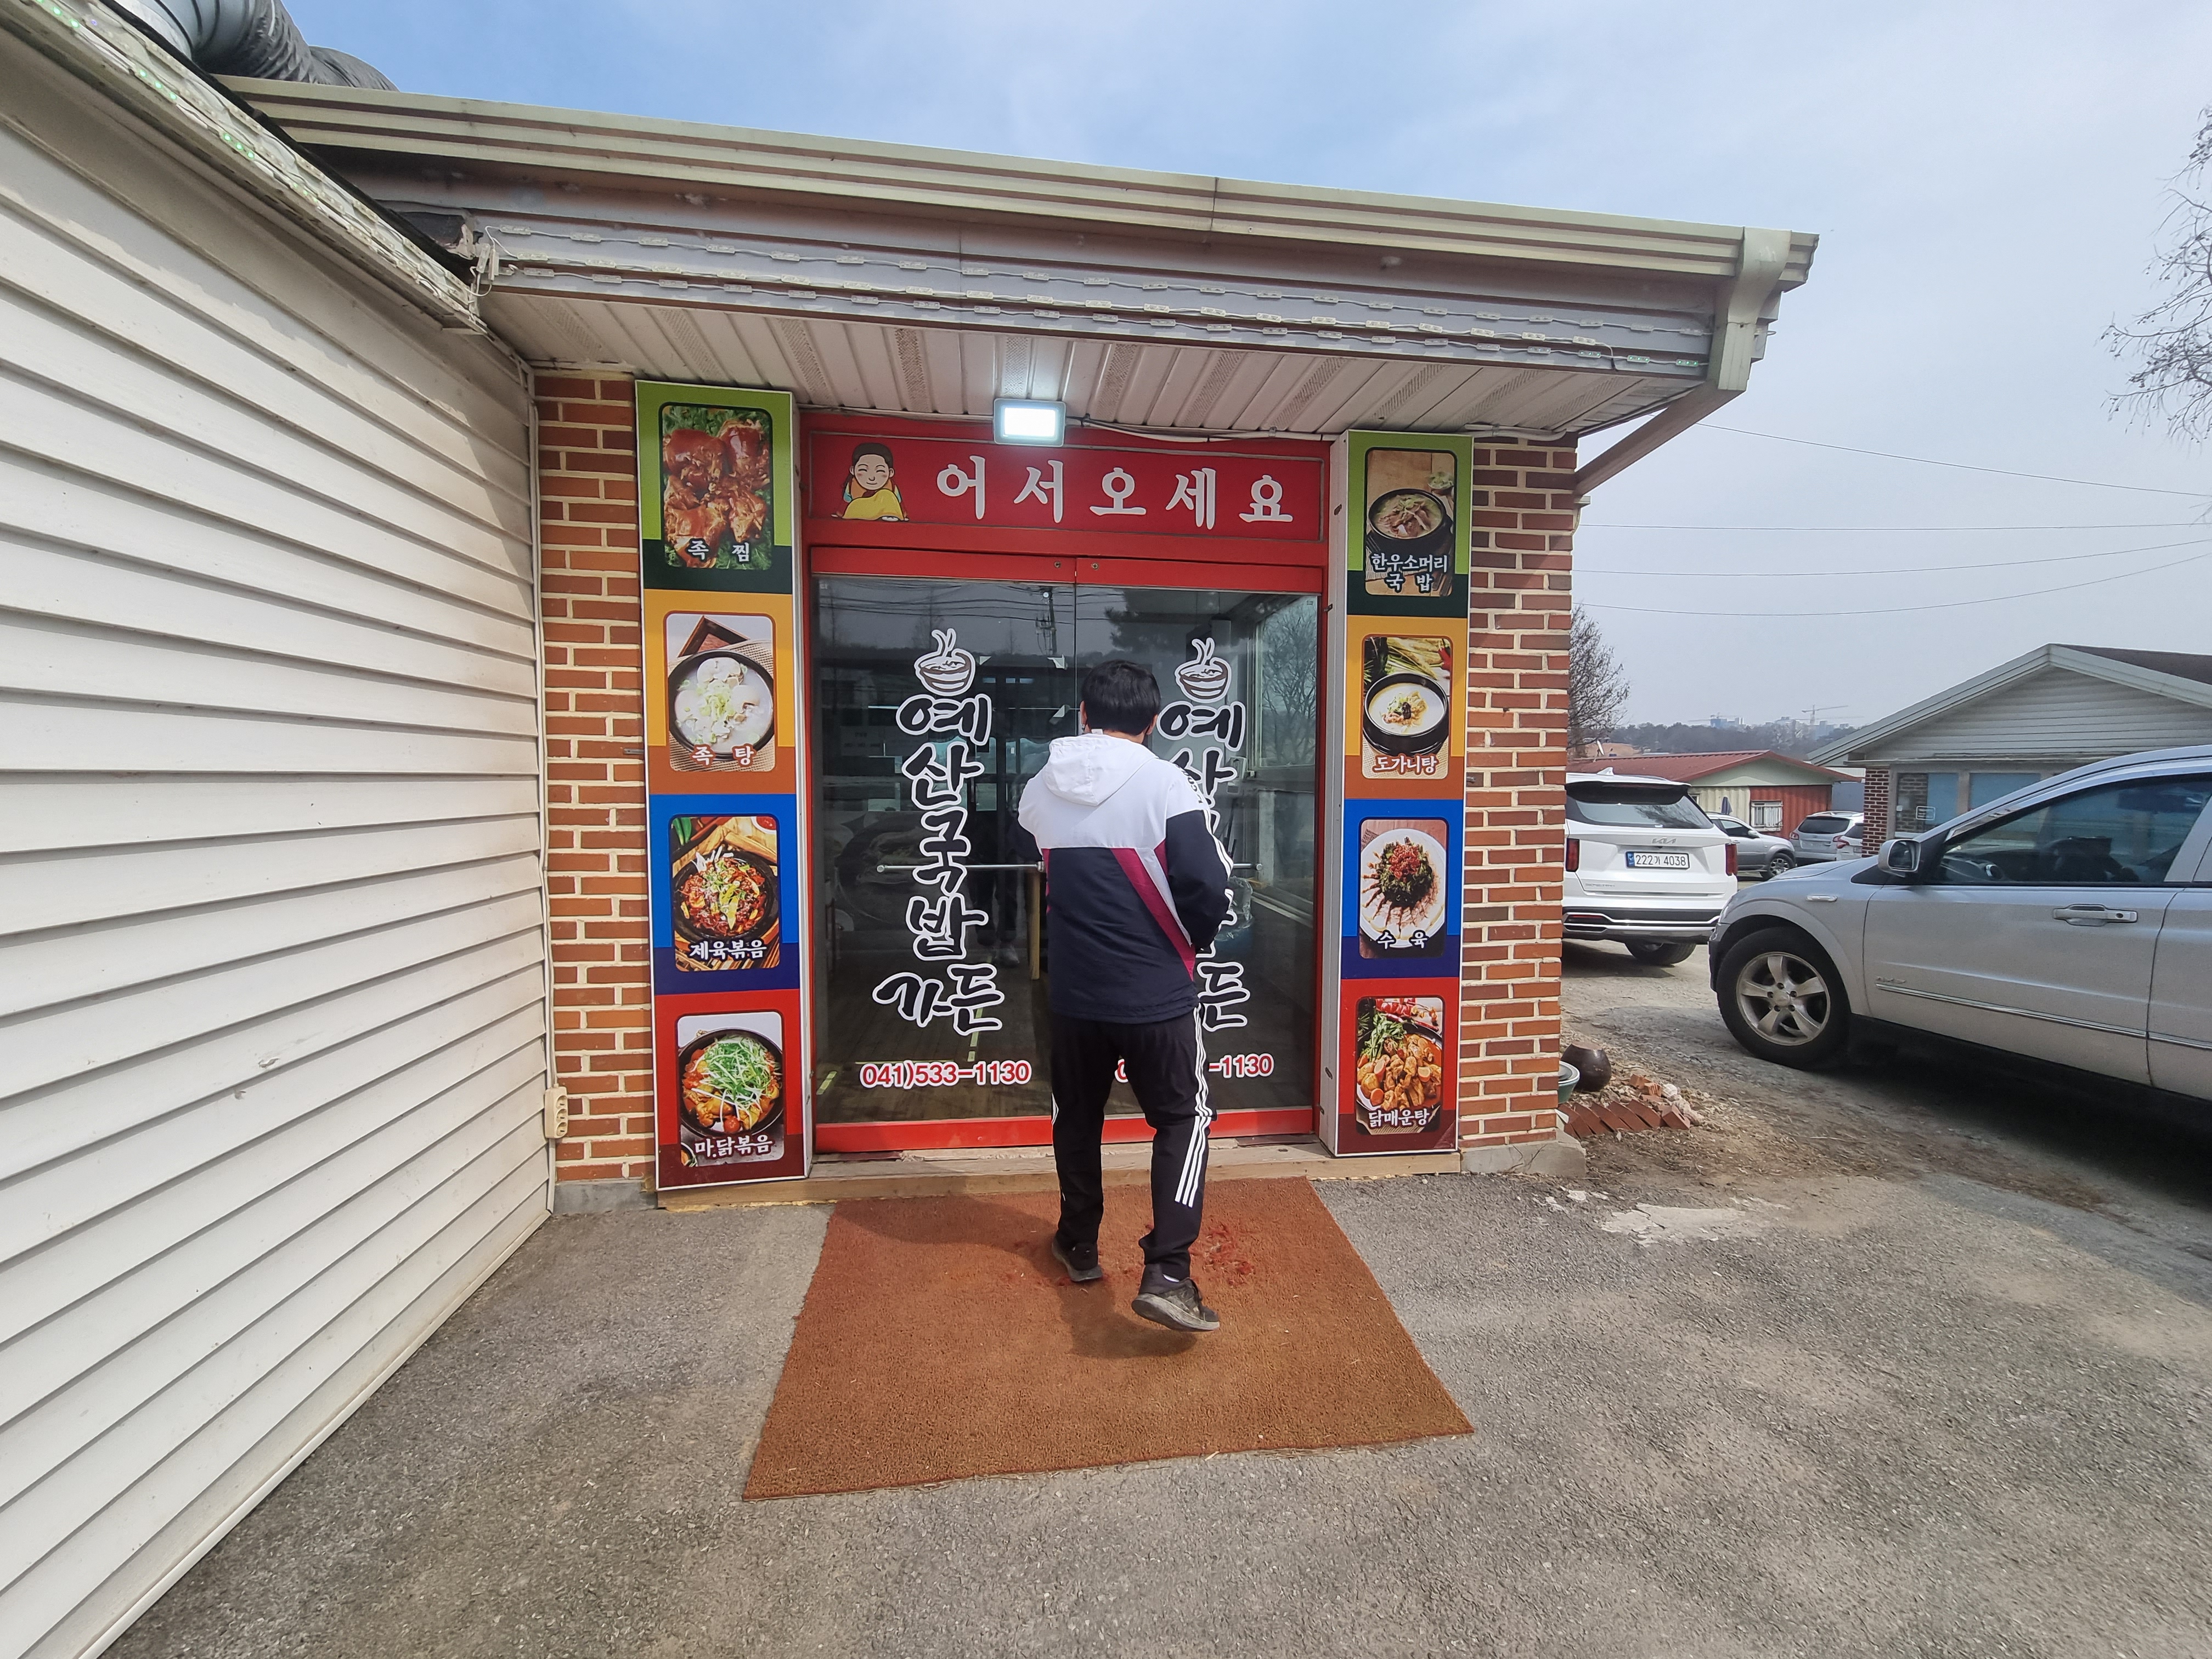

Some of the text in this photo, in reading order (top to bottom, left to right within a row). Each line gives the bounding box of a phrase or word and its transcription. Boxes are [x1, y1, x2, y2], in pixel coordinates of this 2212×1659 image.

[936, 455, 1293, 530] 어서오세요
[1371, 552, 1447, 573] 한우소머리
[1374, 755, 1437, 774] 도가니탕
[1663, 856, 1686, 866] 4038
[690, 940, 767, 960] 제육볶음
[860, 1060, 1031, 1089] 041)533-1130
[1368, 1108, 1430, 1128] 닭매운탕
